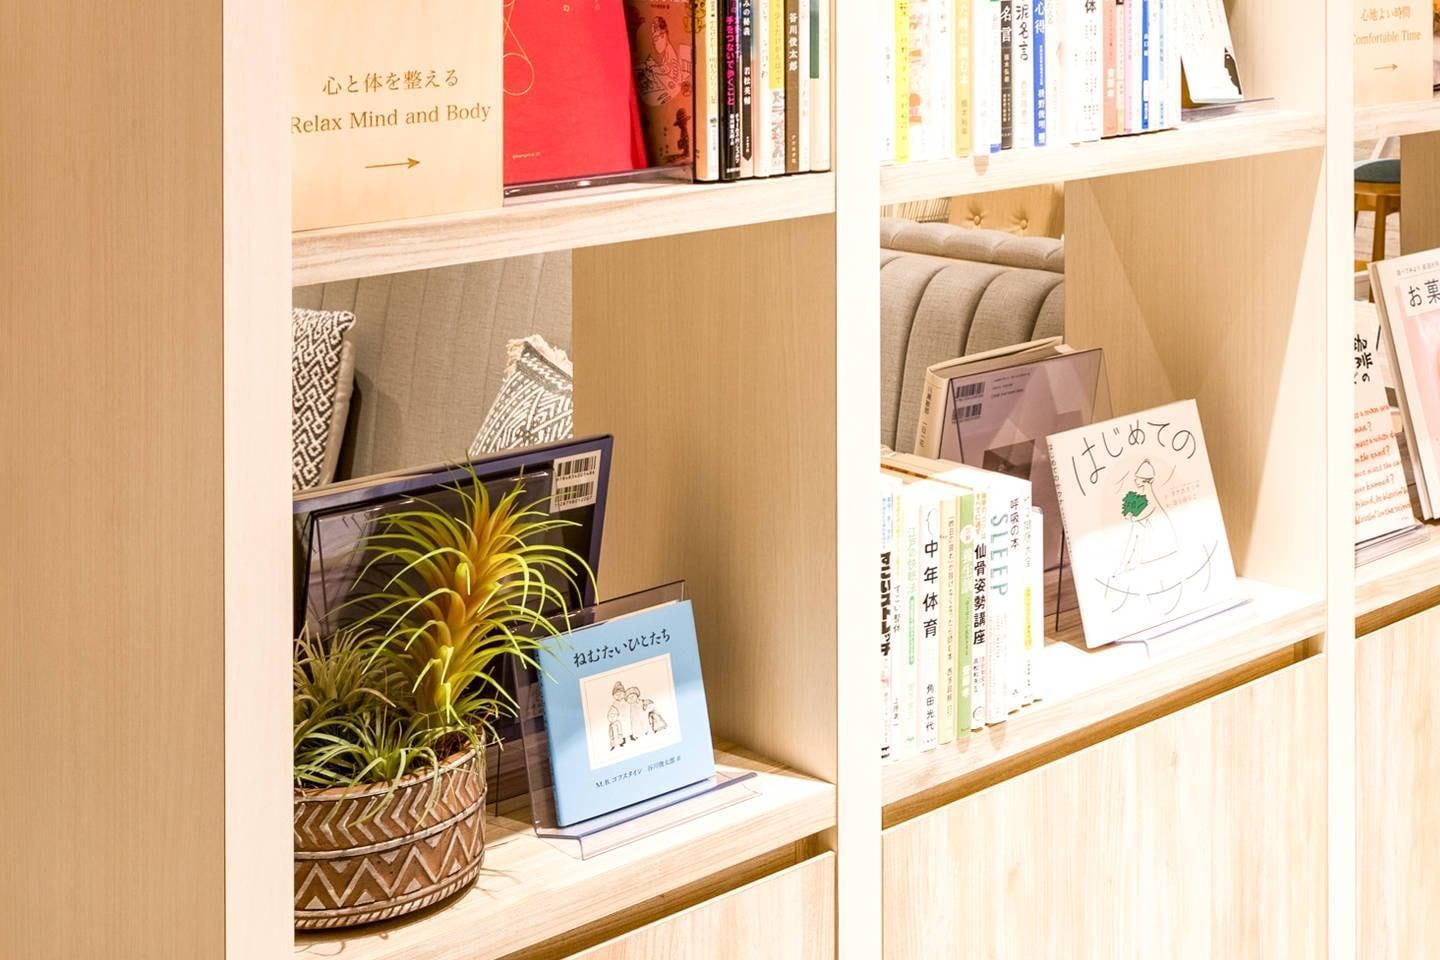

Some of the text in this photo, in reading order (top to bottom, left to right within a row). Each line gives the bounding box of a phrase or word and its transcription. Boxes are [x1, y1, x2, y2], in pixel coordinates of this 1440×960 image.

[1353, 29, 1421, 45] omfortable Time
[1360, 6, 1412, 22] 心地よい時間
[788, 12, 799, 72] 谷川俊太郎
[321, 69, 460, 96] 心と体を整える
[291, 102, 492, 135] Relax Mind and Body
[1071, 419, 1197, 497] はじめての
[1009, 497, 1020, 549] 呼吸の本
[990, 515, 1009, 596] SLEEP
[923, 539, 938, 640] 中年体育
[973, 543, 987, 646] 仙骨姿勢講座
[573, 628, 671, 668] ねむたいひとたち
